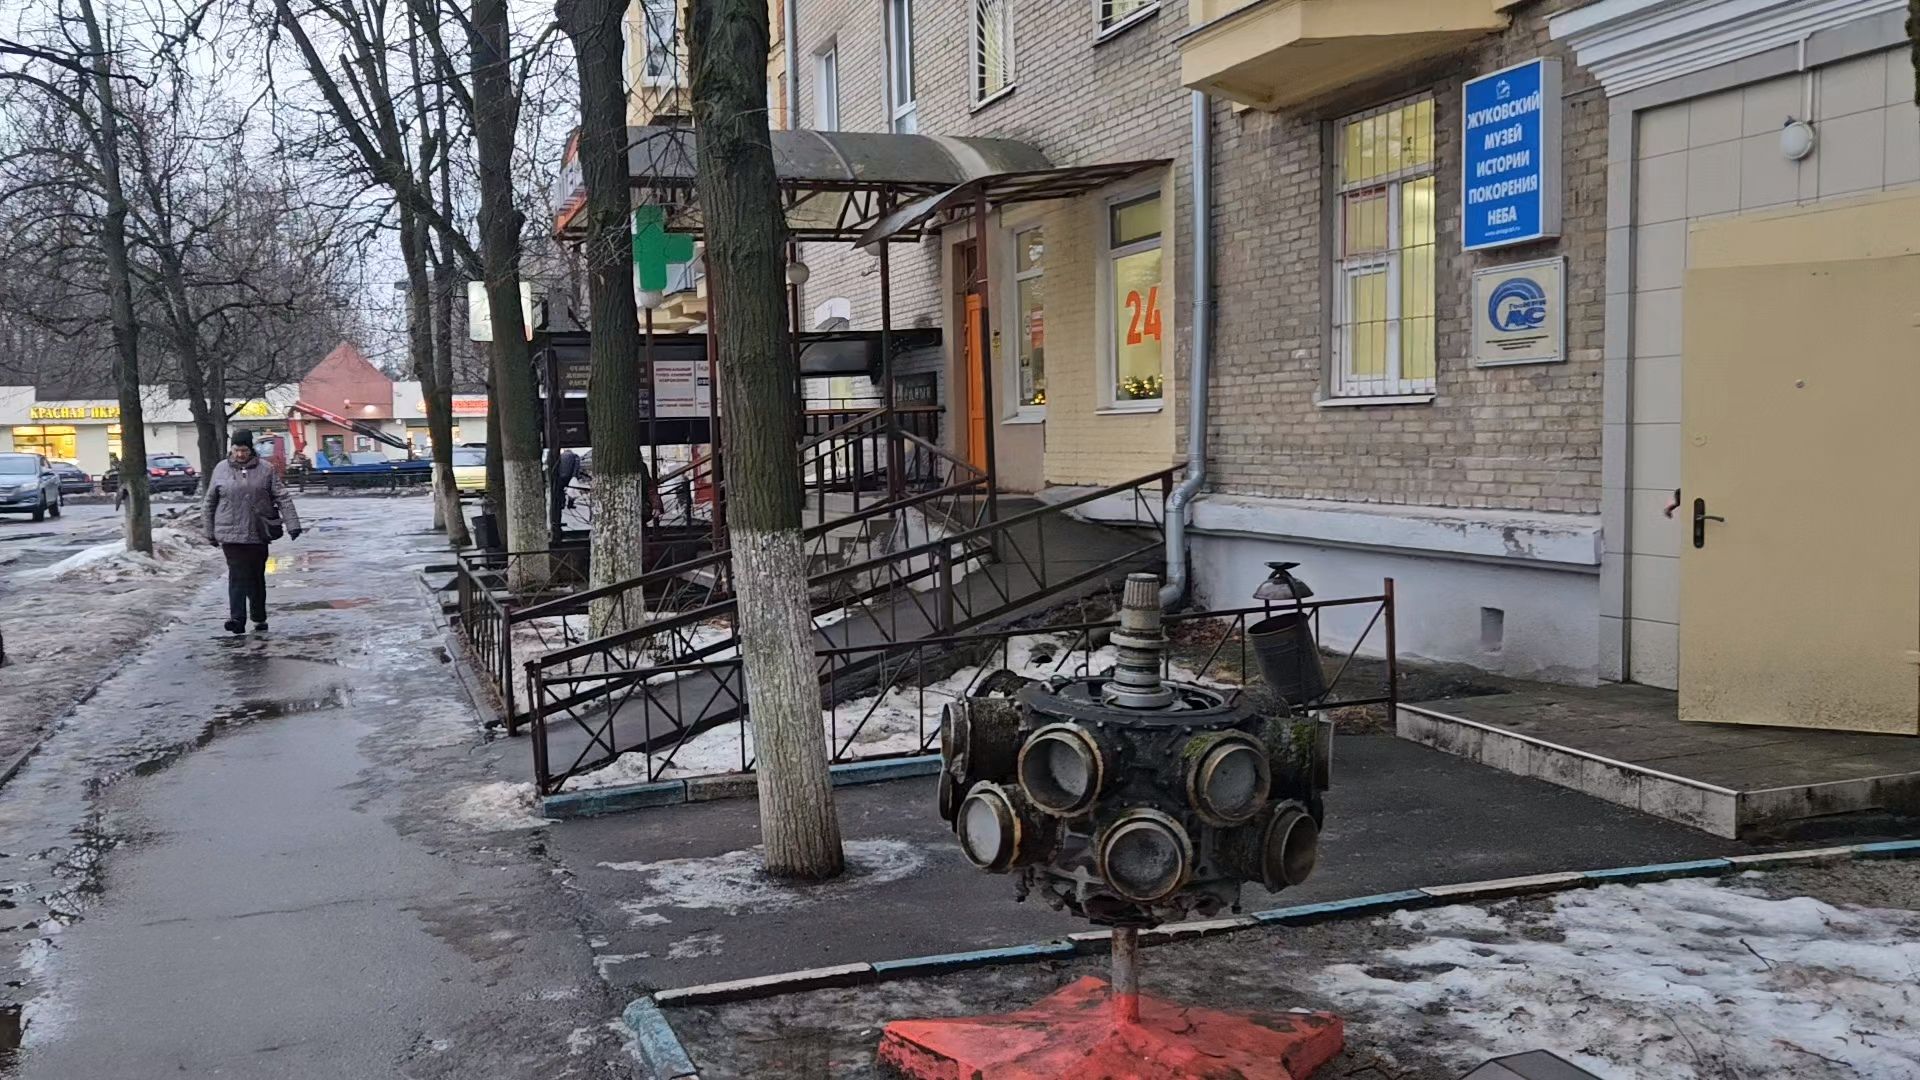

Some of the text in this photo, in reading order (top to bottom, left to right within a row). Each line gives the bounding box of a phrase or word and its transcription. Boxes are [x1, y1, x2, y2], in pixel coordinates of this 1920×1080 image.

[1467, 90, 1540, 130] ЖУКОВСКИЙ
[1484, 123, 1523, 150] МУЗЕЙ
[1476, 149, 1530, 178] ИСТОРИИ
[1468, 174, 1538, 205] ПОКОРЕНИЯ
[1487, 205, 1518, 227] НЕБА
[1125, 286, 1162, 345] 24
[30, 407, 85, 419] КРАСНАЯ
